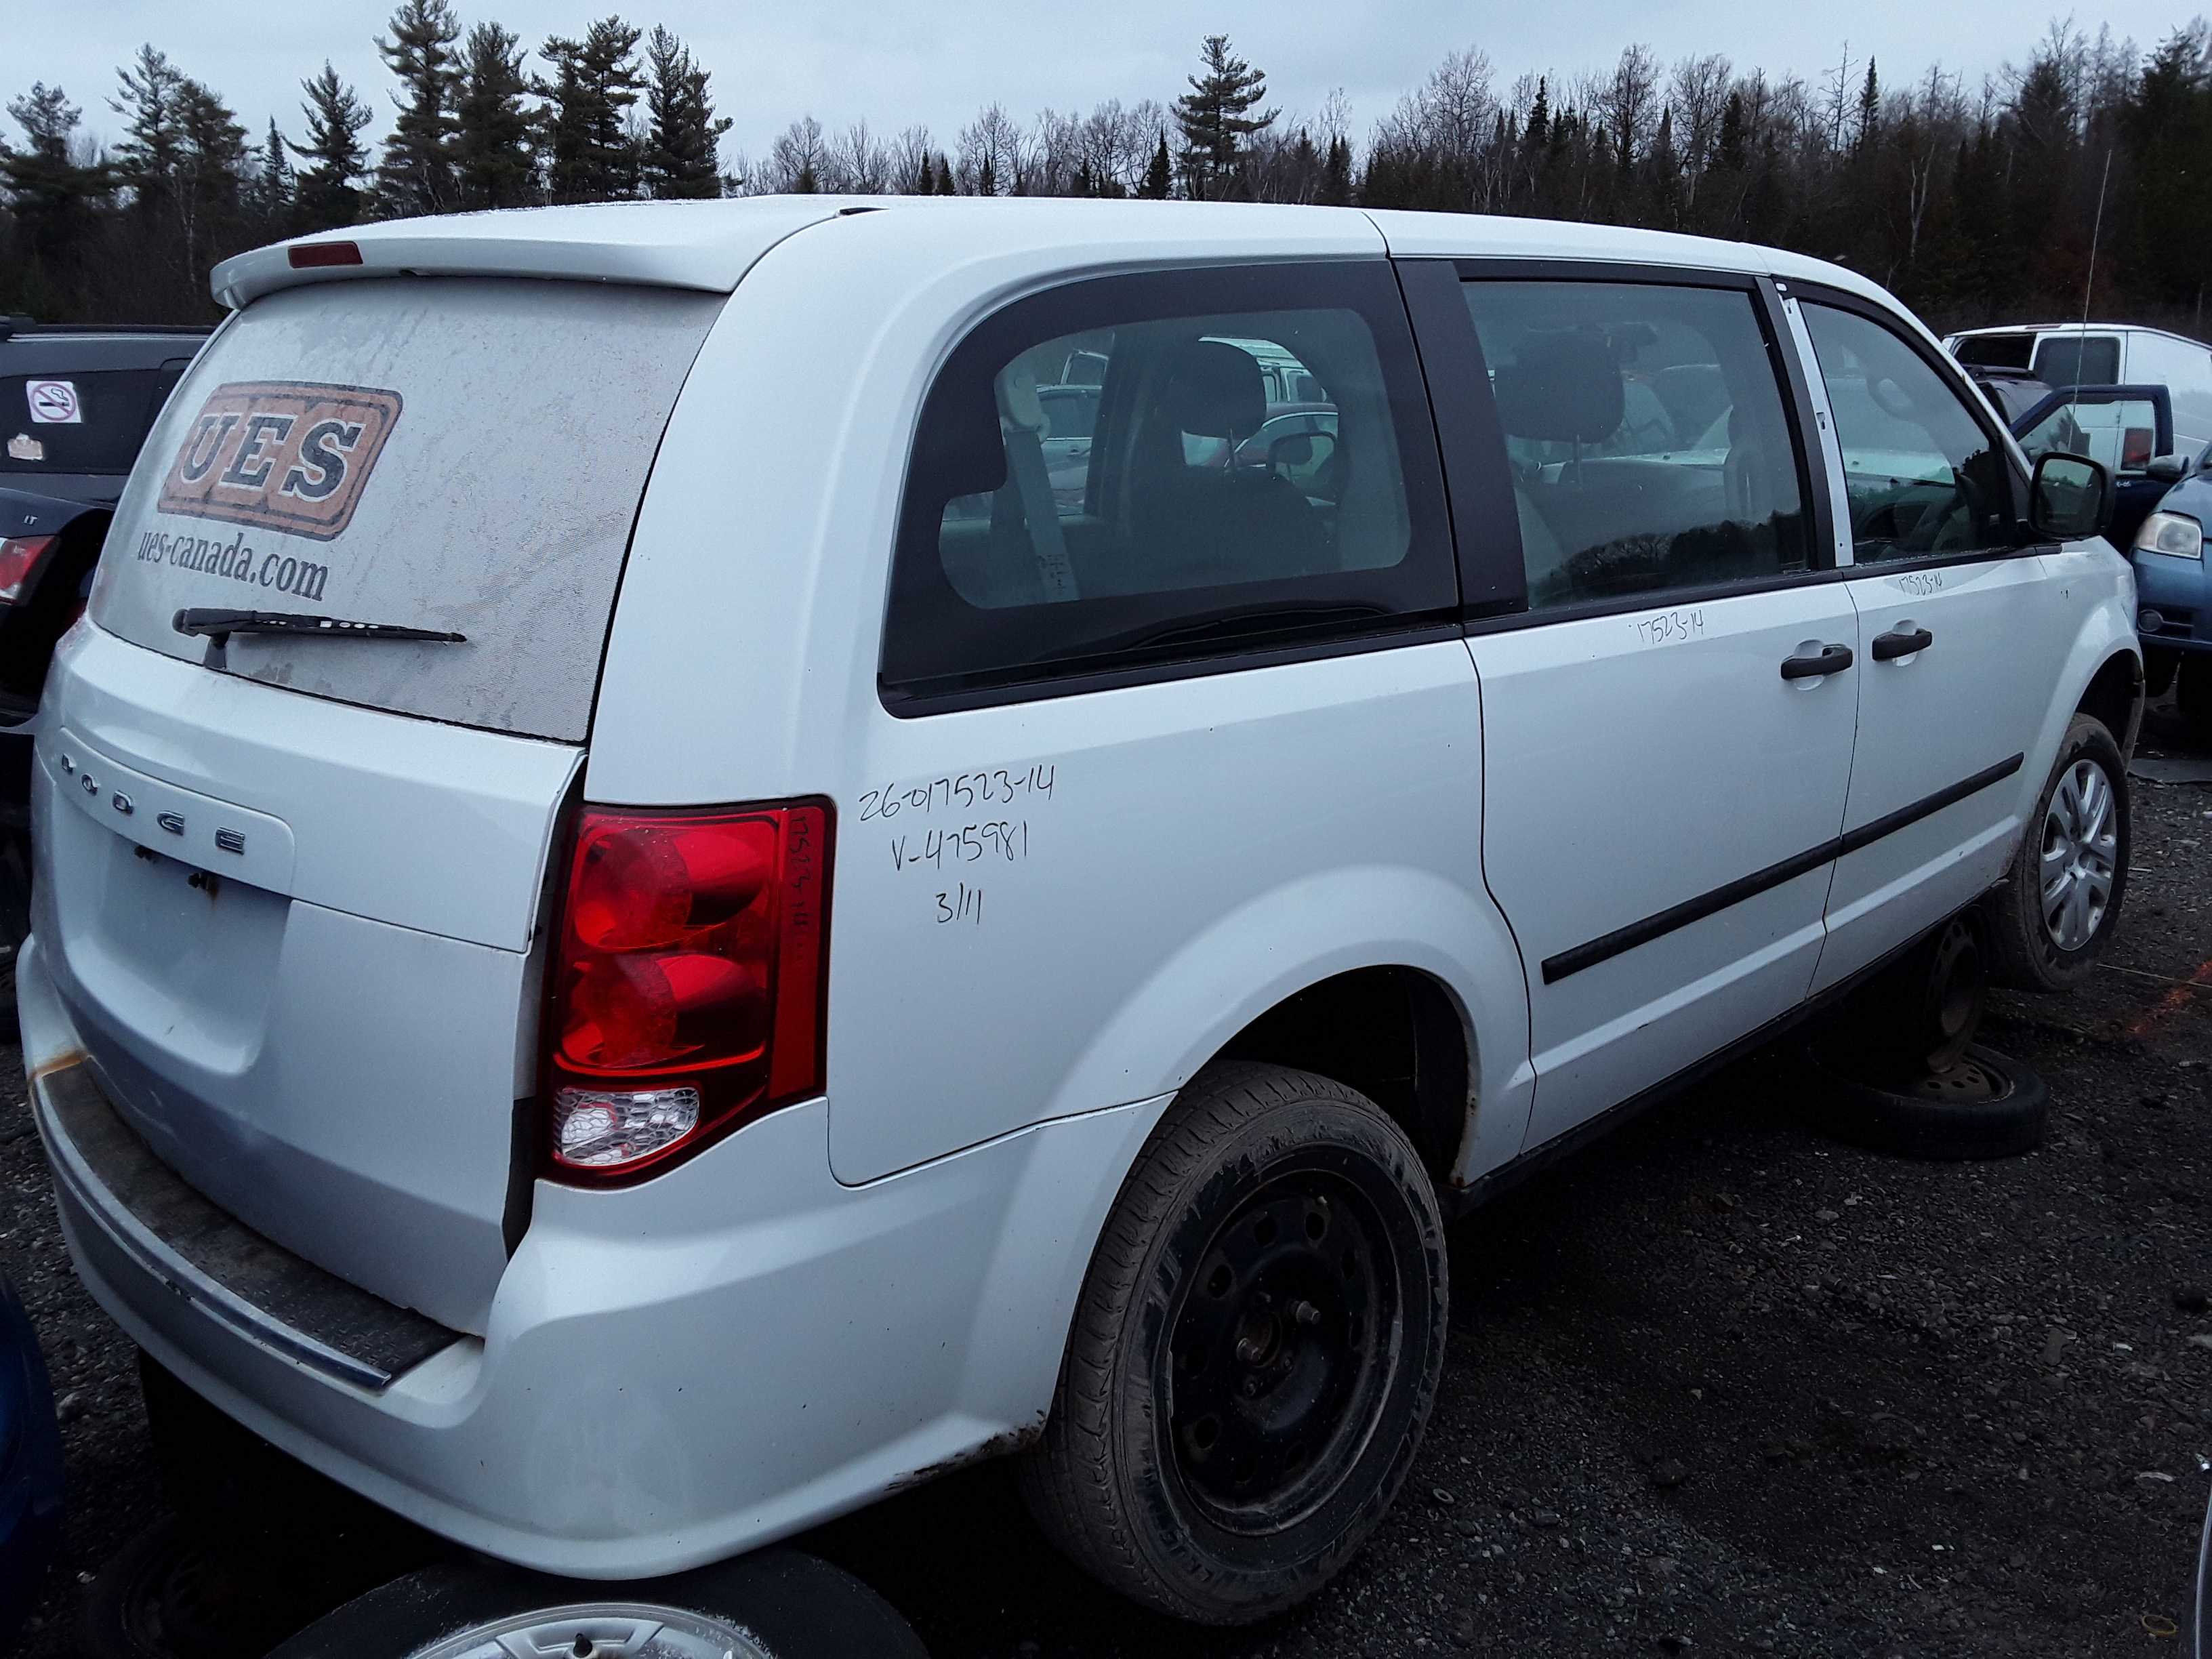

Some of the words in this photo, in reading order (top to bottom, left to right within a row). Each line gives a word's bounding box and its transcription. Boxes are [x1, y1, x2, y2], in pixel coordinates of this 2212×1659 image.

[181, 412, 365, 502] UES
[137, 531, 329, 602] ues-canada.com
[1637, 609, 1704, 644] 17523-14
[61, 753, 245, 855] DODGE
[859, 764, 1054, 821] 26-017523-14
